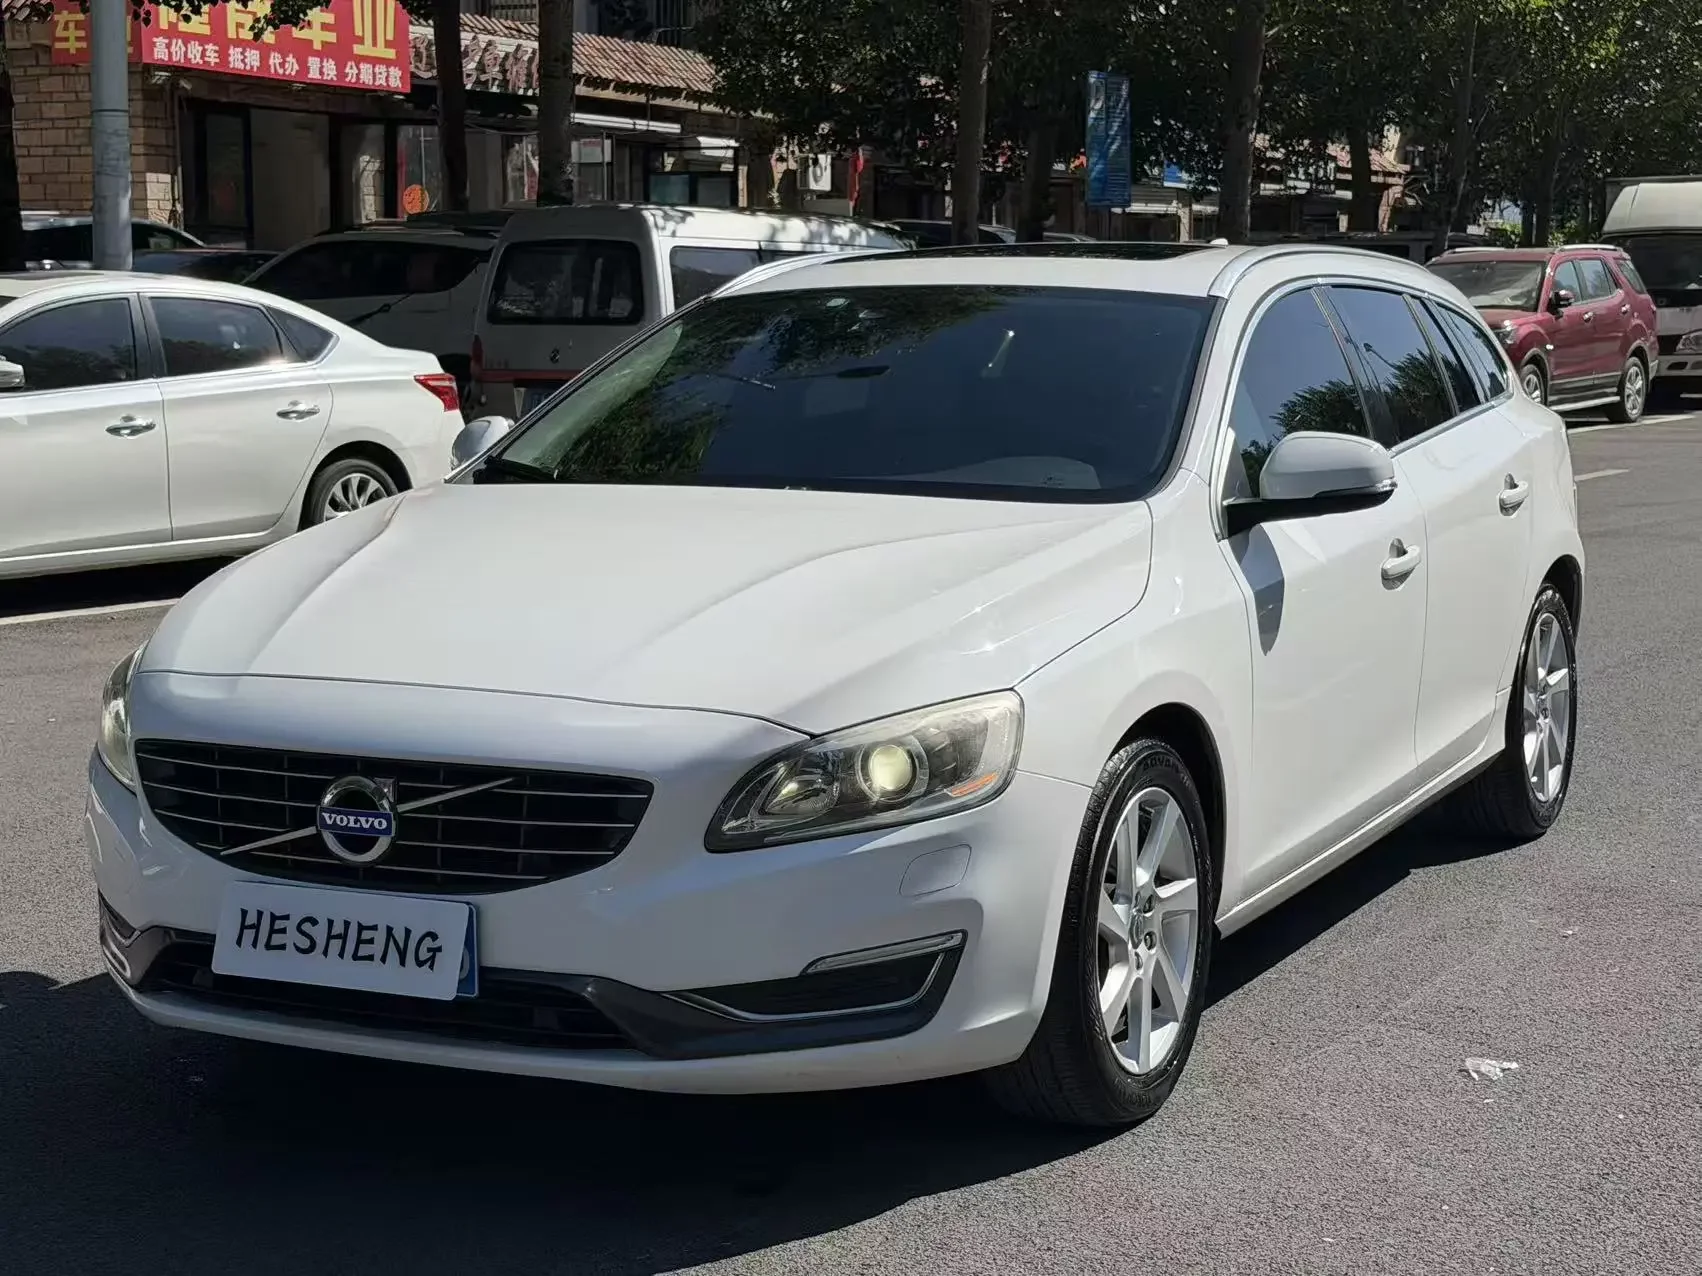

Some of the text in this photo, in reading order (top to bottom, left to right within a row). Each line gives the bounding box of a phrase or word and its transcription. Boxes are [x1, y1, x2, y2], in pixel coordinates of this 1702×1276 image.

[152, 36, 402, 88] 高价收车 抵押 代办 置换 分期贷款
[322, 812, 388, 830] VOLVO
[235, 907, 443, 972] HESHENG
